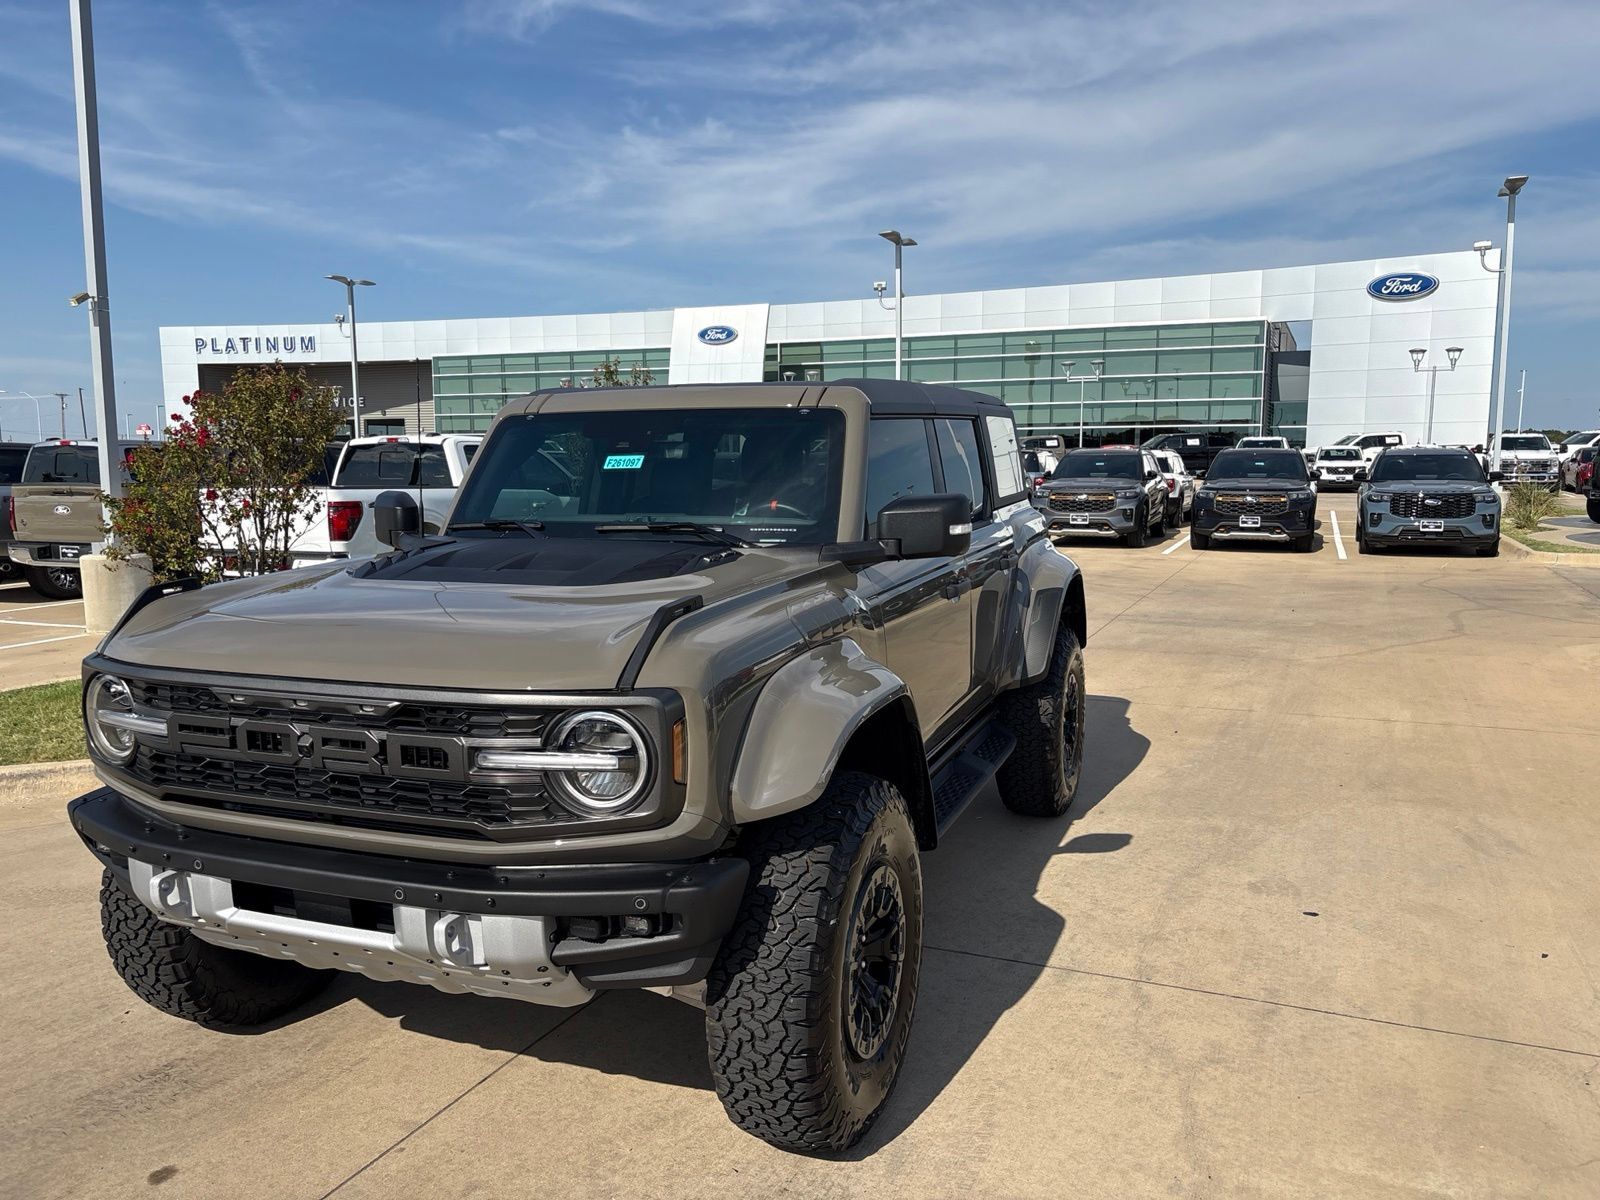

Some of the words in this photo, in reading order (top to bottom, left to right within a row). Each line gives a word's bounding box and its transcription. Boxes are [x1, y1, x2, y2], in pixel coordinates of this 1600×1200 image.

[1381, 277, 1422, 294] Ford
[704, 328, 728, 340] Ford
[195, 335, 316, 354] PLATINUM
[606, 458, 642, 468] F261097
[171, 712, 464, 782] FORD
